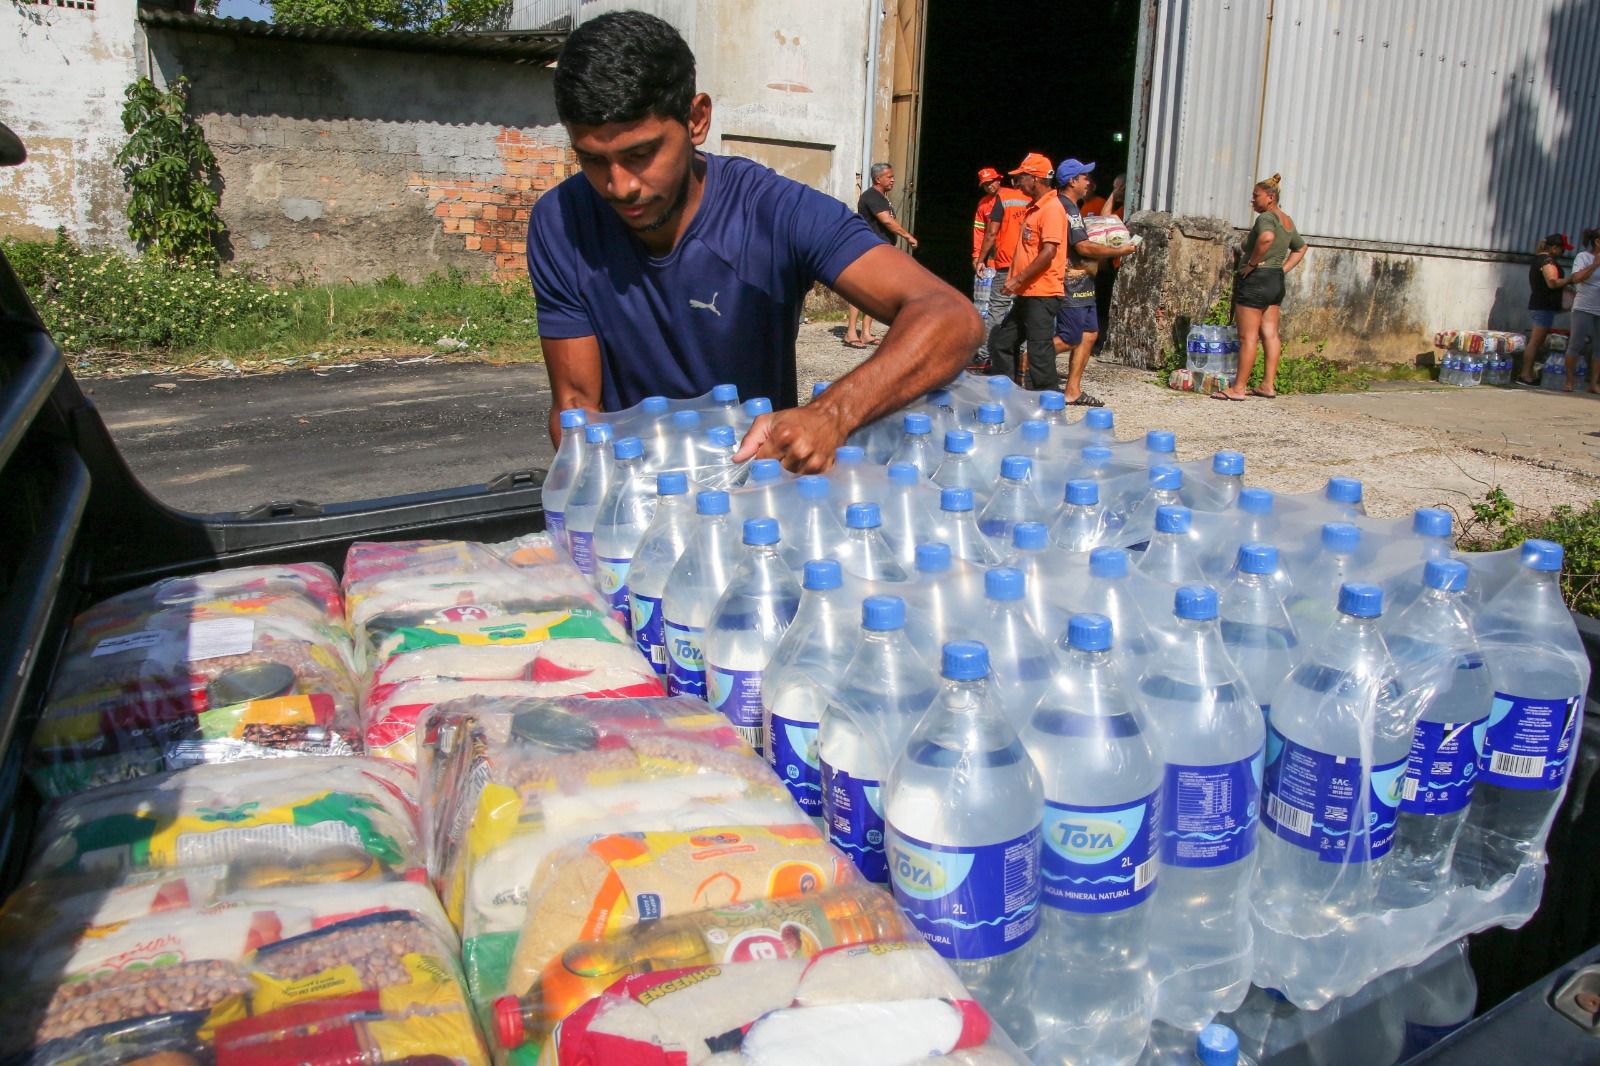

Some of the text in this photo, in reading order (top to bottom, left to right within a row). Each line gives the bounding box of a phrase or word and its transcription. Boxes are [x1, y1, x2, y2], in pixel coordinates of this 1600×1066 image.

[1331, 777, 1350, 786] SAC
[1059, 822, 1115, 849] TOYA
[892, 845, 932, 888] TOYA
[1121, 856, 1133, 868] 2L
[1064, 890, 1098, 901] MINERAL
[1098, 888, 1131, 901] NATURAL
[952, 903, 968, 915] 2L
[638, 967, 721, 1005] ENGENHO
